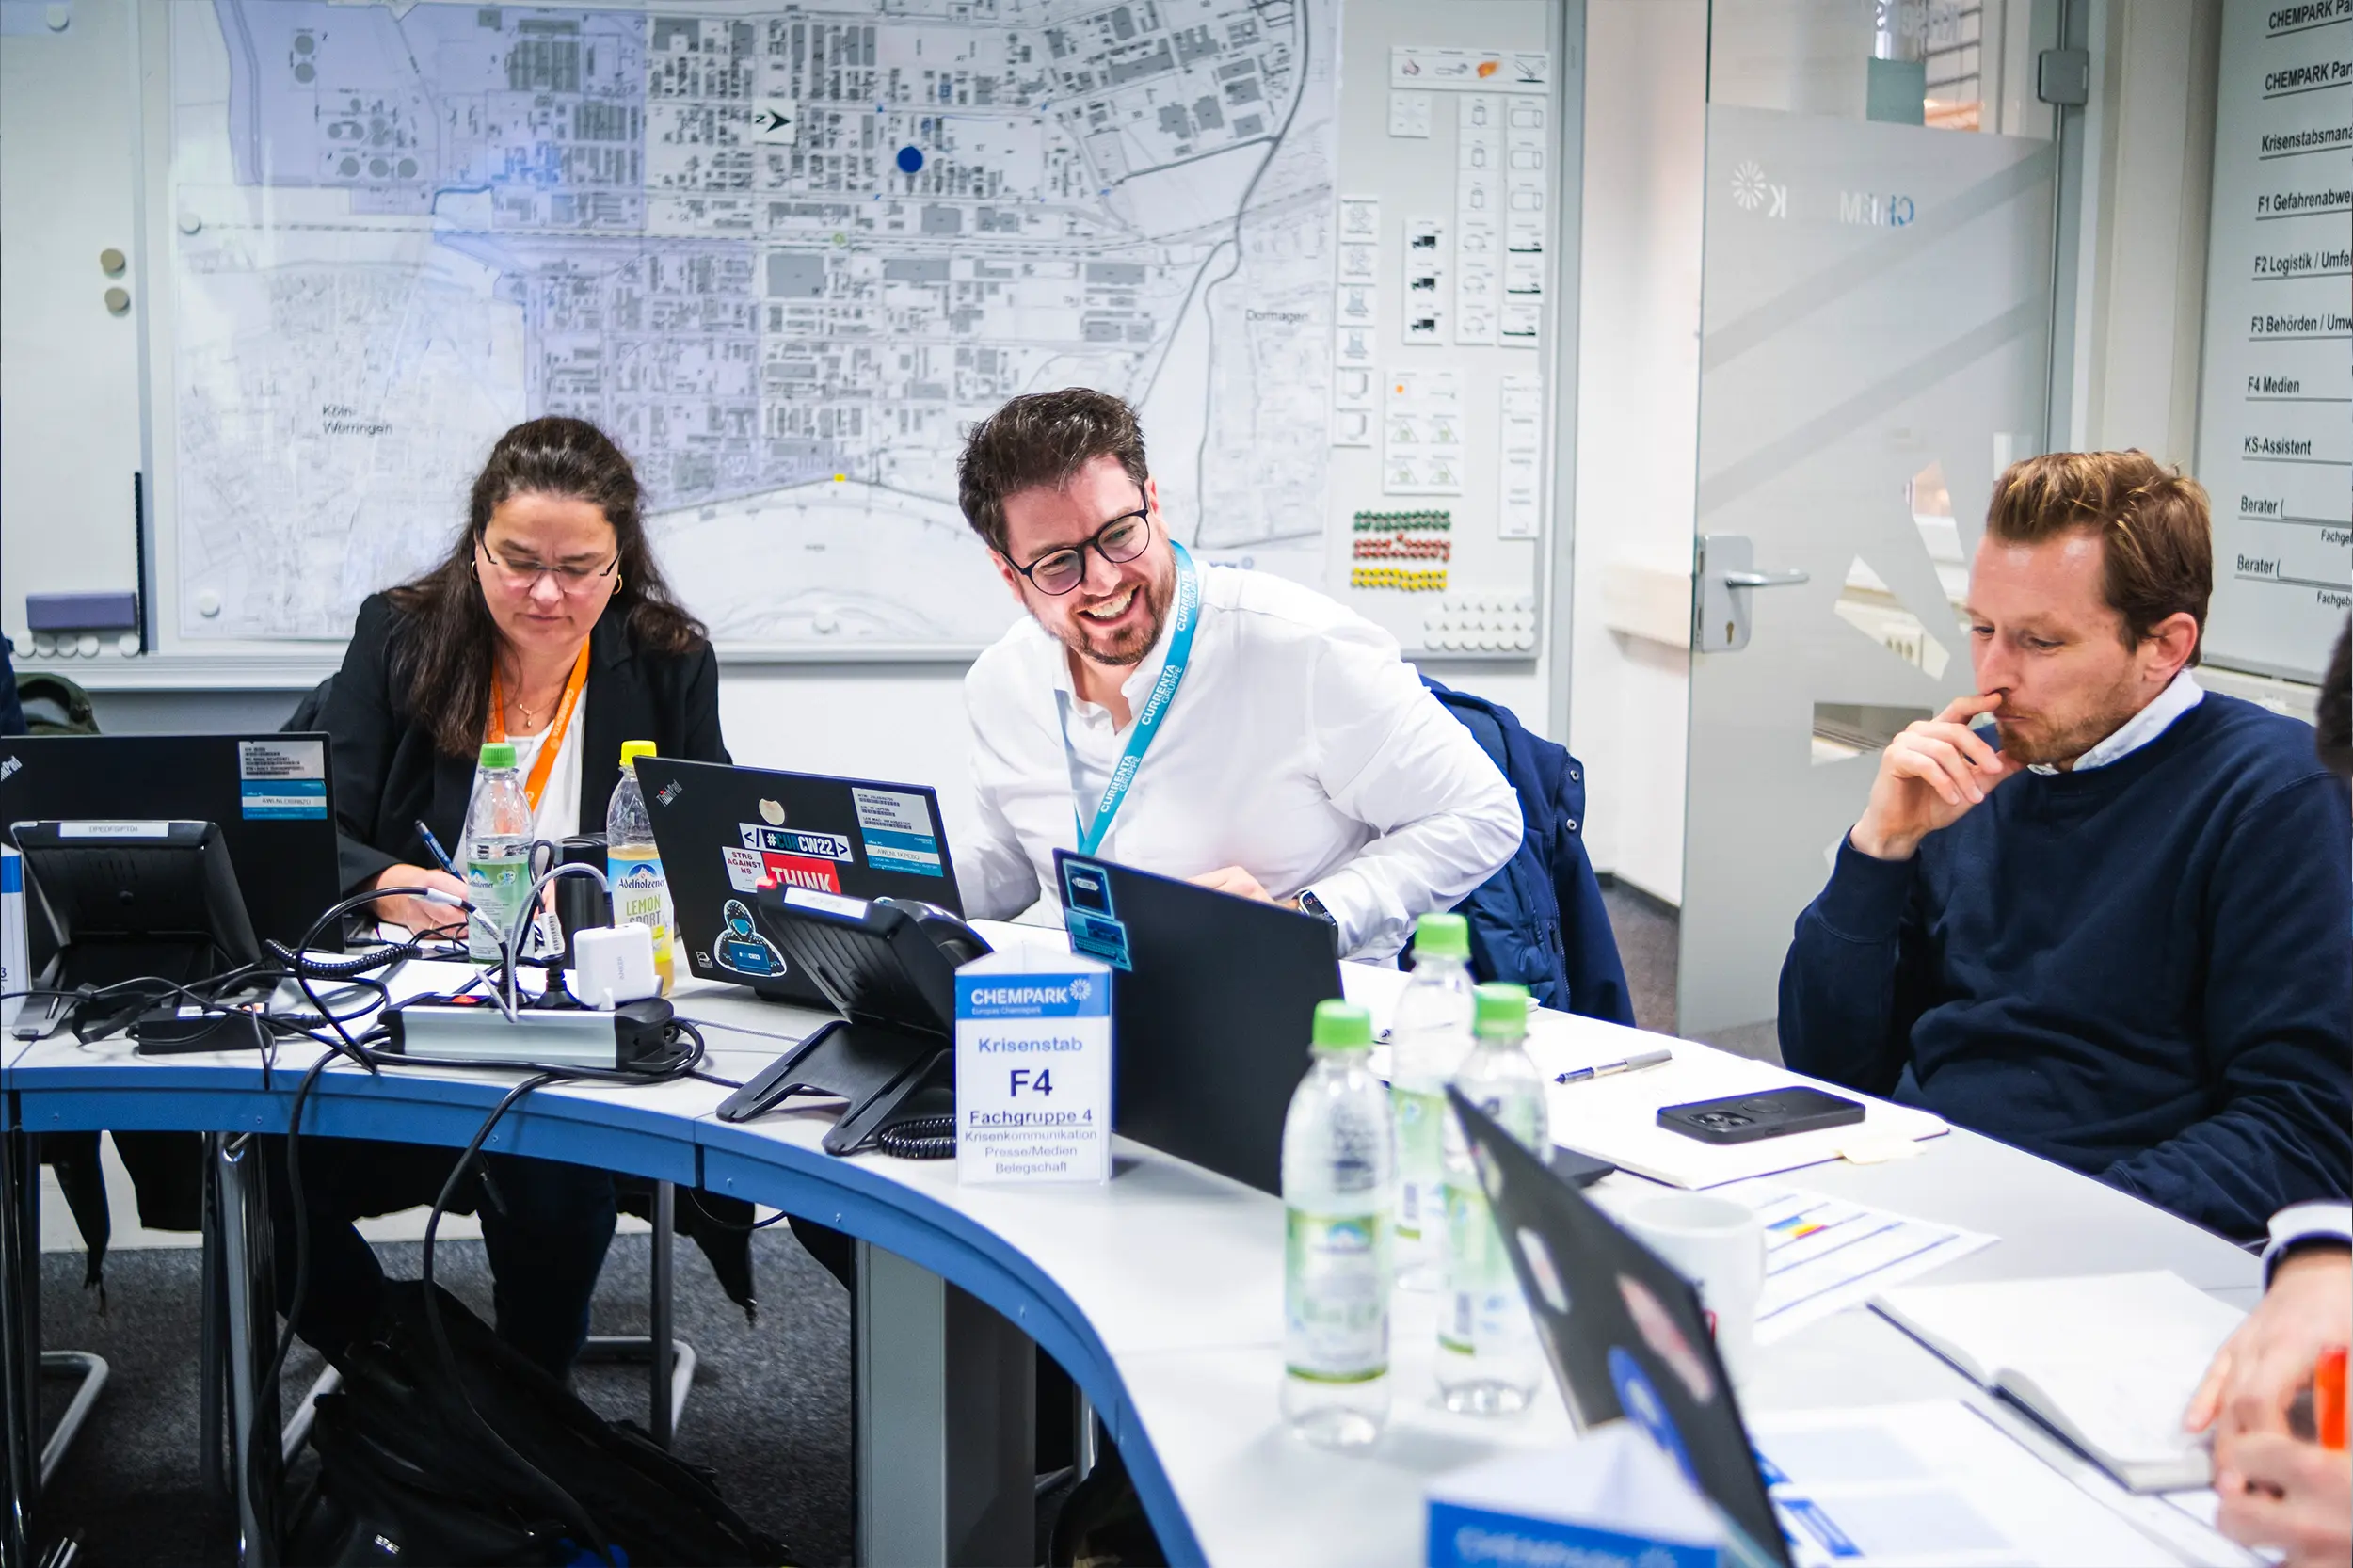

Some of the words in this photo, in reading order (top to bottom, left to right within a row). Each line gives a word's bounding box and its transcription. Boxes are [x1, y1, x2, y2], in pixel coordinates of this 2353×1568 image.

[2268, 0, 2333, 30] CHEMPARK
[2265, 63, 2329, 91] CHEMPARK
[2331, 60, 2352, 79] Par
[2257, 195, 2270, 213] F1
[2273, 188, 2352, 211] Gefahrenabwe
[2254, 255, 2267, 273] F2
[2269, 252, 2312, 277] Logistik
[1245, 309, 1309, 325] Dormagen
[2250, 315, 2264, 333] F3
[2265, 313, 2317, 333] Behörden
[2248, 376, 2260, 392] F4
[2263, 376, 2300, 393] Medien
[2244, 435, 2312, 456] KS-Assistent
[2240, 494, 2278, 515] Berater
[2237, 553, 2274, 575] Berater
[1141, 664, 1176, 726] CURRENTA
[1160, 665, 1183, 705] GRUPPE
[1099, 754, 1134, 813] CURRENTA
[1118, 755, 1141, 792] GRUPPE
[766, 832, 836, 856] #CURCW22
[728, 858, 761, 869] AGAINST
[731, 851, 753, 860] STR8
[741, 867, 752, 875] H8
[771, 867, 832, 893] THINK
[617, 878, 665, 889] Adelholzener
[626, 894, 661, 916] LEMON
[970, 986, 1069, 1006] CHEMPARK
[978, 1036, 1083, 1053] Krisenstab
[1009, 1068, 1054, 1097] F4
[969, 1110, 1078, 1127] Fachgruppe
[1082, 1108, 1093, 1122] 4
[964, 1130, 1097, 1143] Krisenkommunikation
[984, 1145, 1078, 1158] Presse/Medien
[995, 1161, 1068, 1175] Belegschaft
